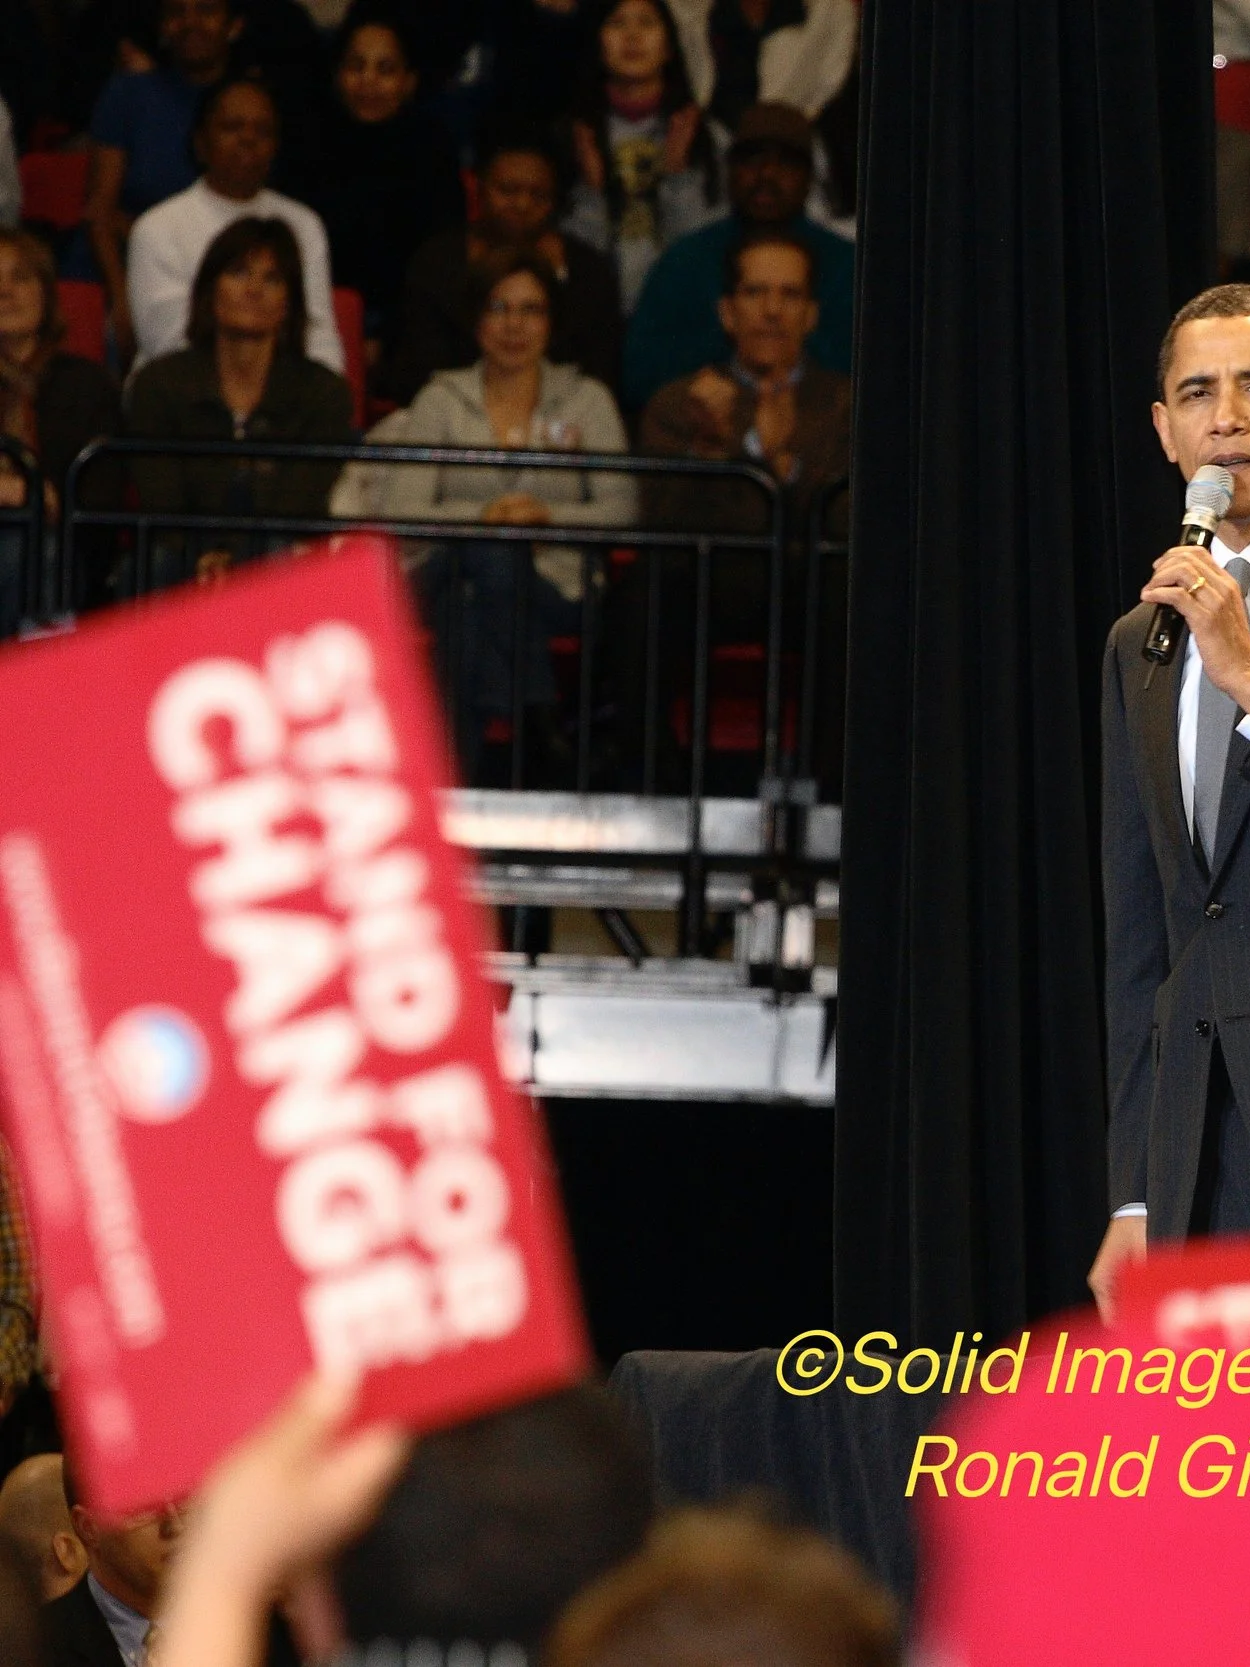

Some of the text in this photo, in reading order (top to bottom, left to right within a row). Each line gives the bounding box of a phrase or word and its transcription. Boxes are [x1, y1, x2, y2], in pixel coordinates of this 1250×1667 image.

[146, 656, 440, 1370] CHANGE
[264, 621, 529, 1342] STAND FOR
